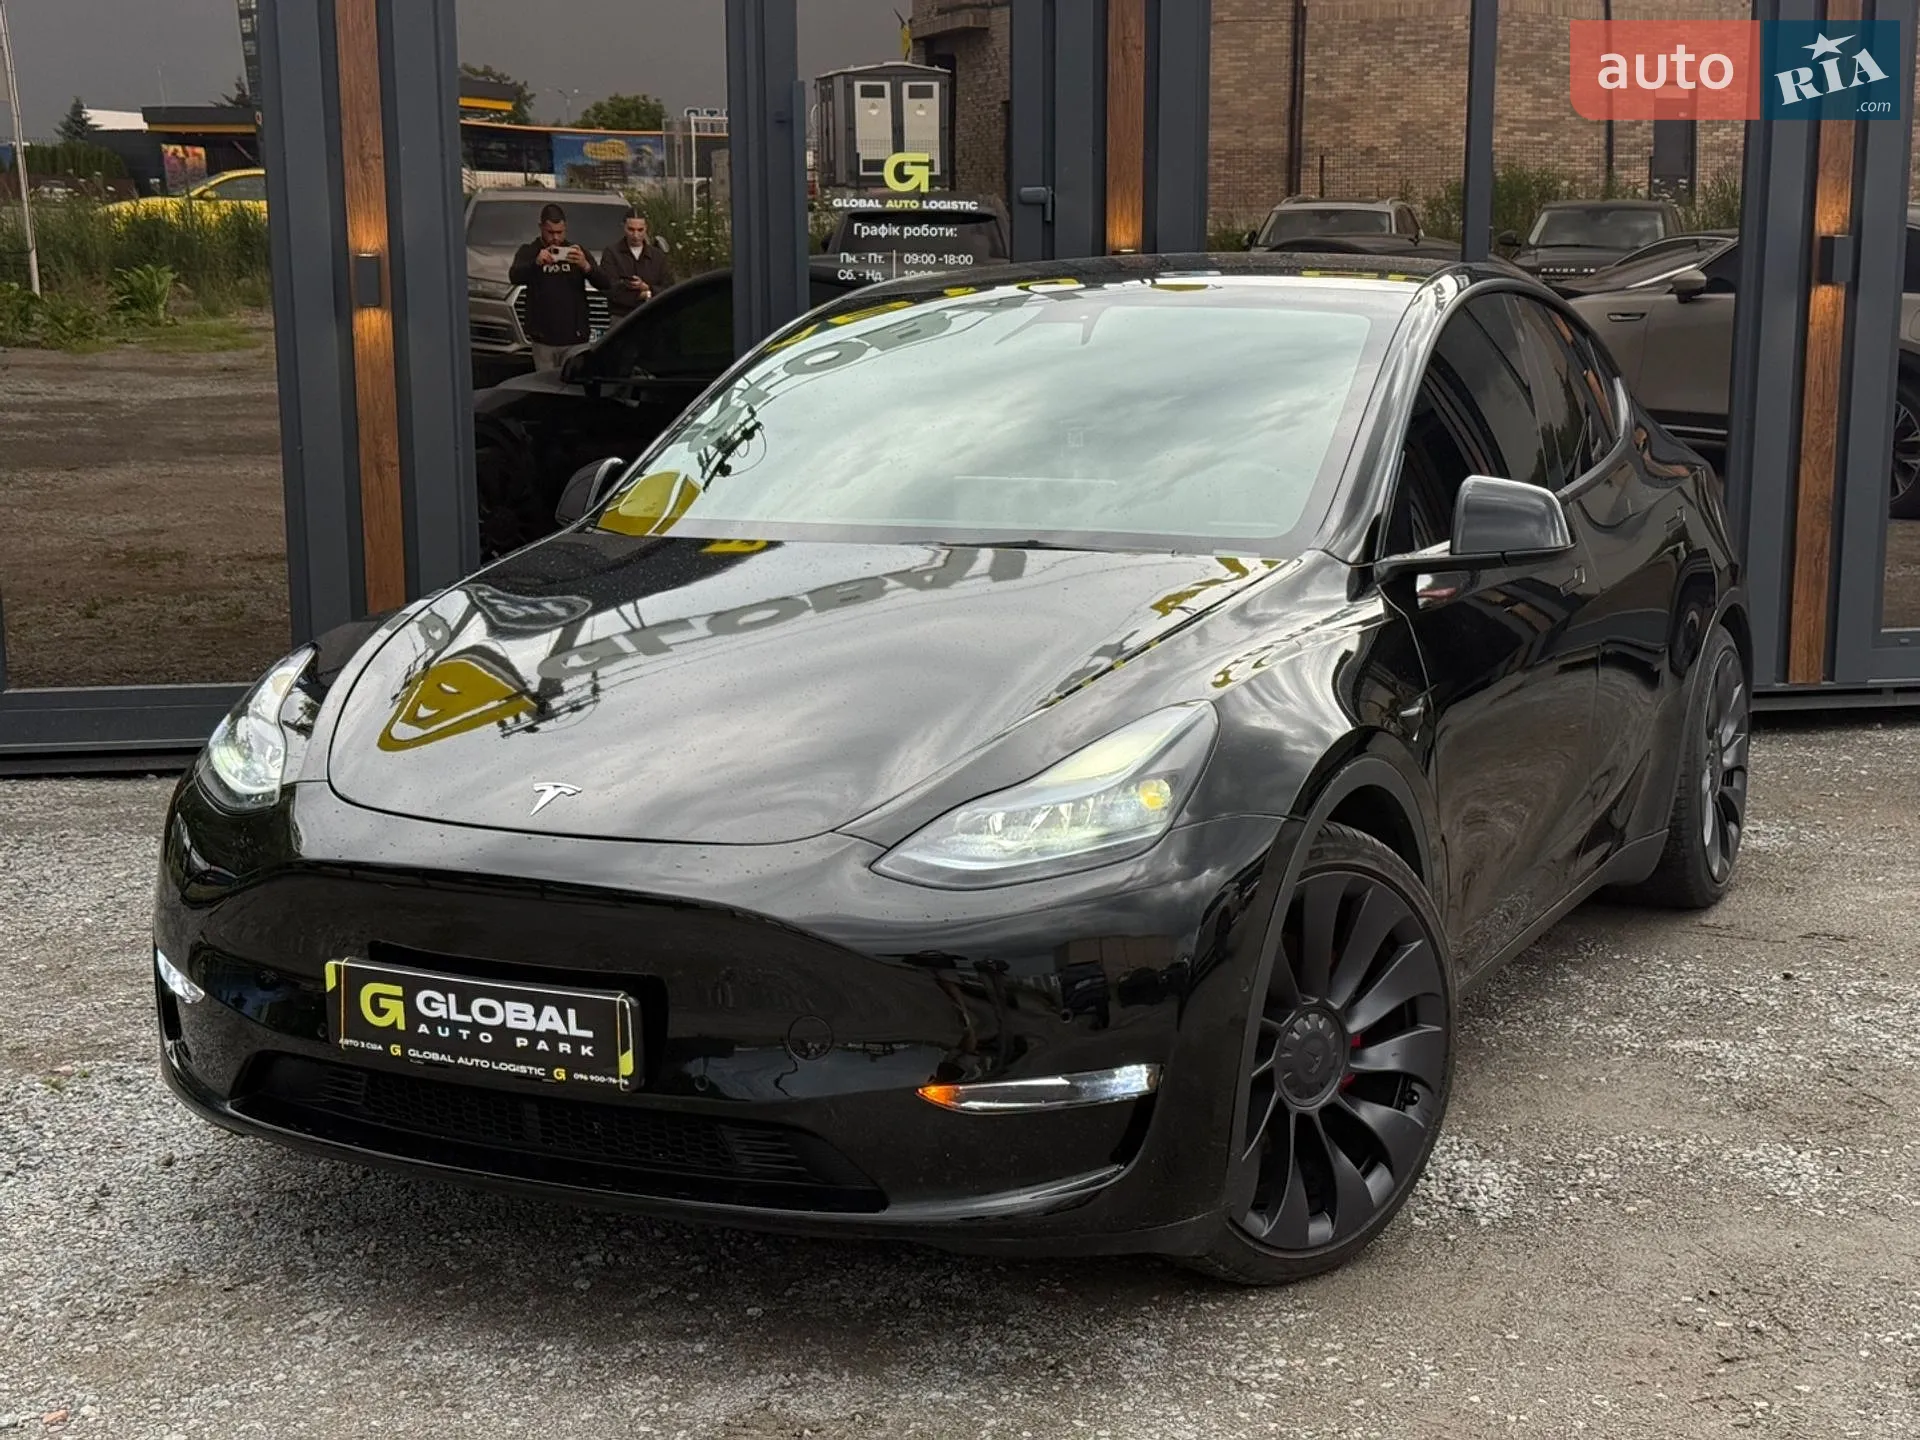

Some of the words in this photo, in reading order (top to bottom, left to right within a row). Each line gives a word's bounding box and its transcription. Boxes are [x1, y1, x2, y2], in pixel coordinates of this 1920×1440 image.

[832, 198, 882, 208] GLOBAL
[886, 198, 920, 208] AUTO
[922, 200, 978, 210] LOGISTIC
[853, 222, 900, 238] Графік
[903, 224, 958, 238] роботи:
[840, 252, 858, 264] Пн.
[868, 253, 885, 264] Пт.
[904, 253, 936, 265] 09:00
[838, 269, 856, 280] Сб.
[866, 270, 885, 282] Нд.
[416, 990, 594, 1038] GLOBAL
[418, 1024, 493, 1044] AUTO
[516, 1036, 594, 1057] PARK
[408, 1048, 455, 1063] GLOBAL
[457, 1056, 490, 1070] AUTO
[492, 1061, 546, 1076] LOGISTIC
